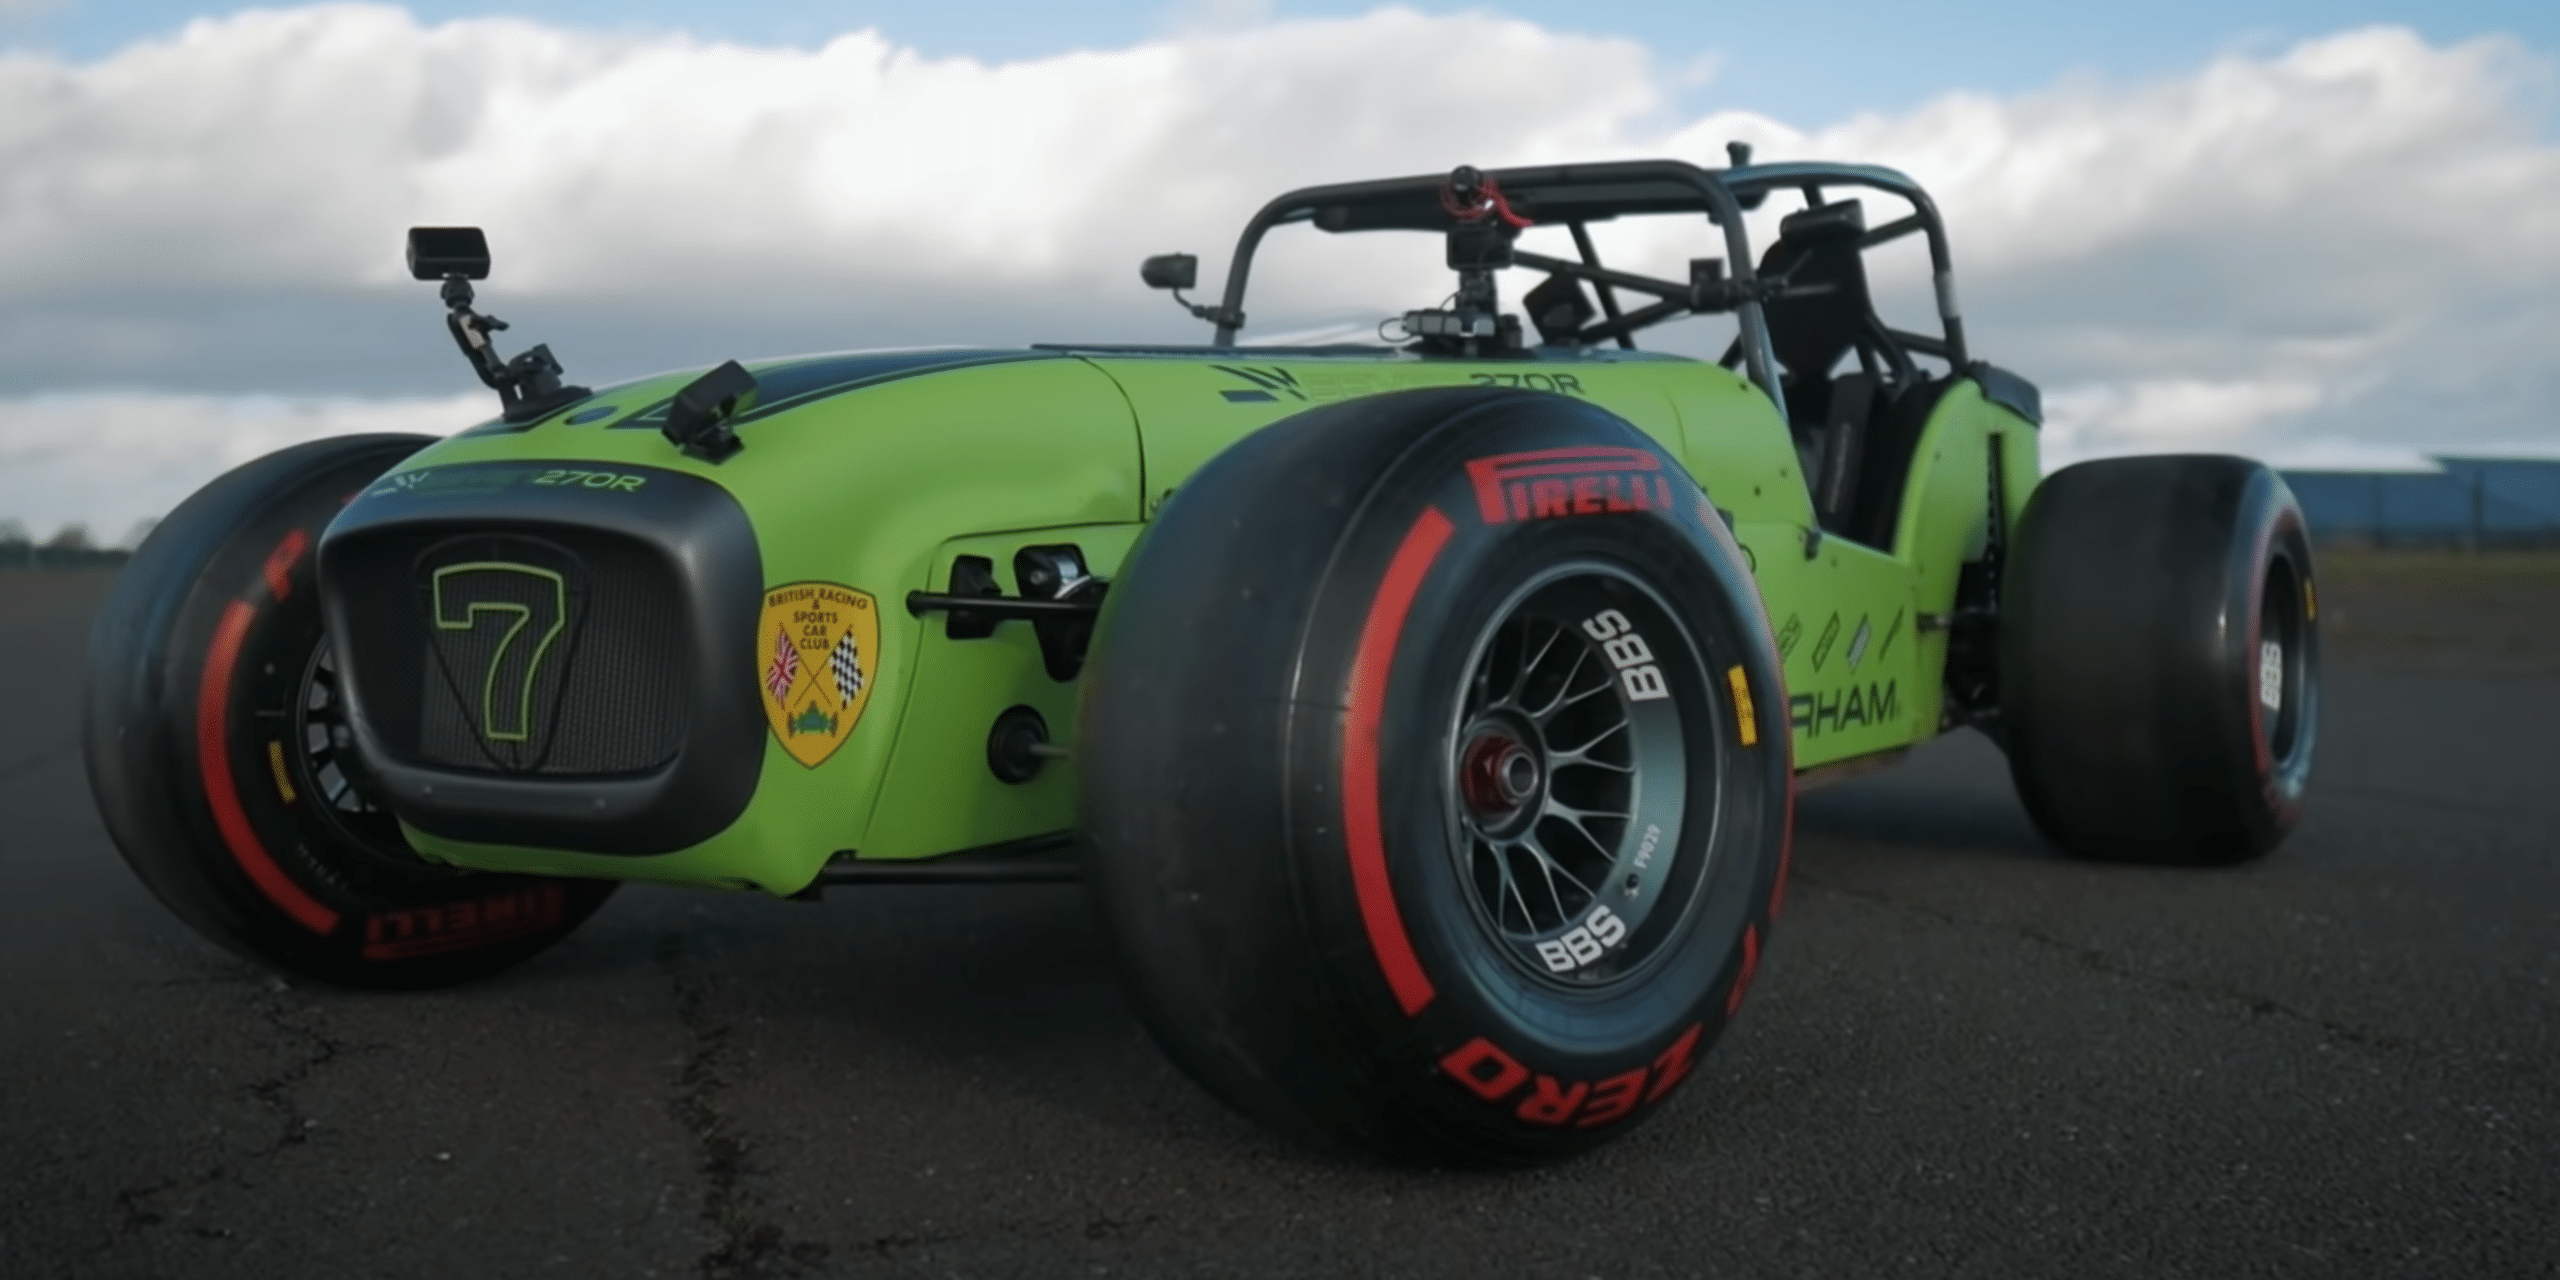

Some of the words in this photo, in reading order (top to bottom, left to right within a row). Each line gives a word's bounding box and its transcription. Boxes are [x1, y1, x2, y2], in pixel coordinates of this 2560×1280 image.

[532, 469, 646, 491] 270R
[1463, 445, 1675, 526] PIRELLI
[769, 588, 814, 608] BRITISH
[819, 587, 868, 610] RACING
[793, 610, 838, 624] SPORTS
[802, 625, 827, 637] CAR
[433, 561, 565, 741] 7
[800, 638, 829, 650] CLUB
[1581, 609, 1669, 701] BBS
[2260, 641, 2282, 711] BBS
[1535, 904, 1626, 972] BBS
[1438, 1020, 1704, 1127] ZERO
